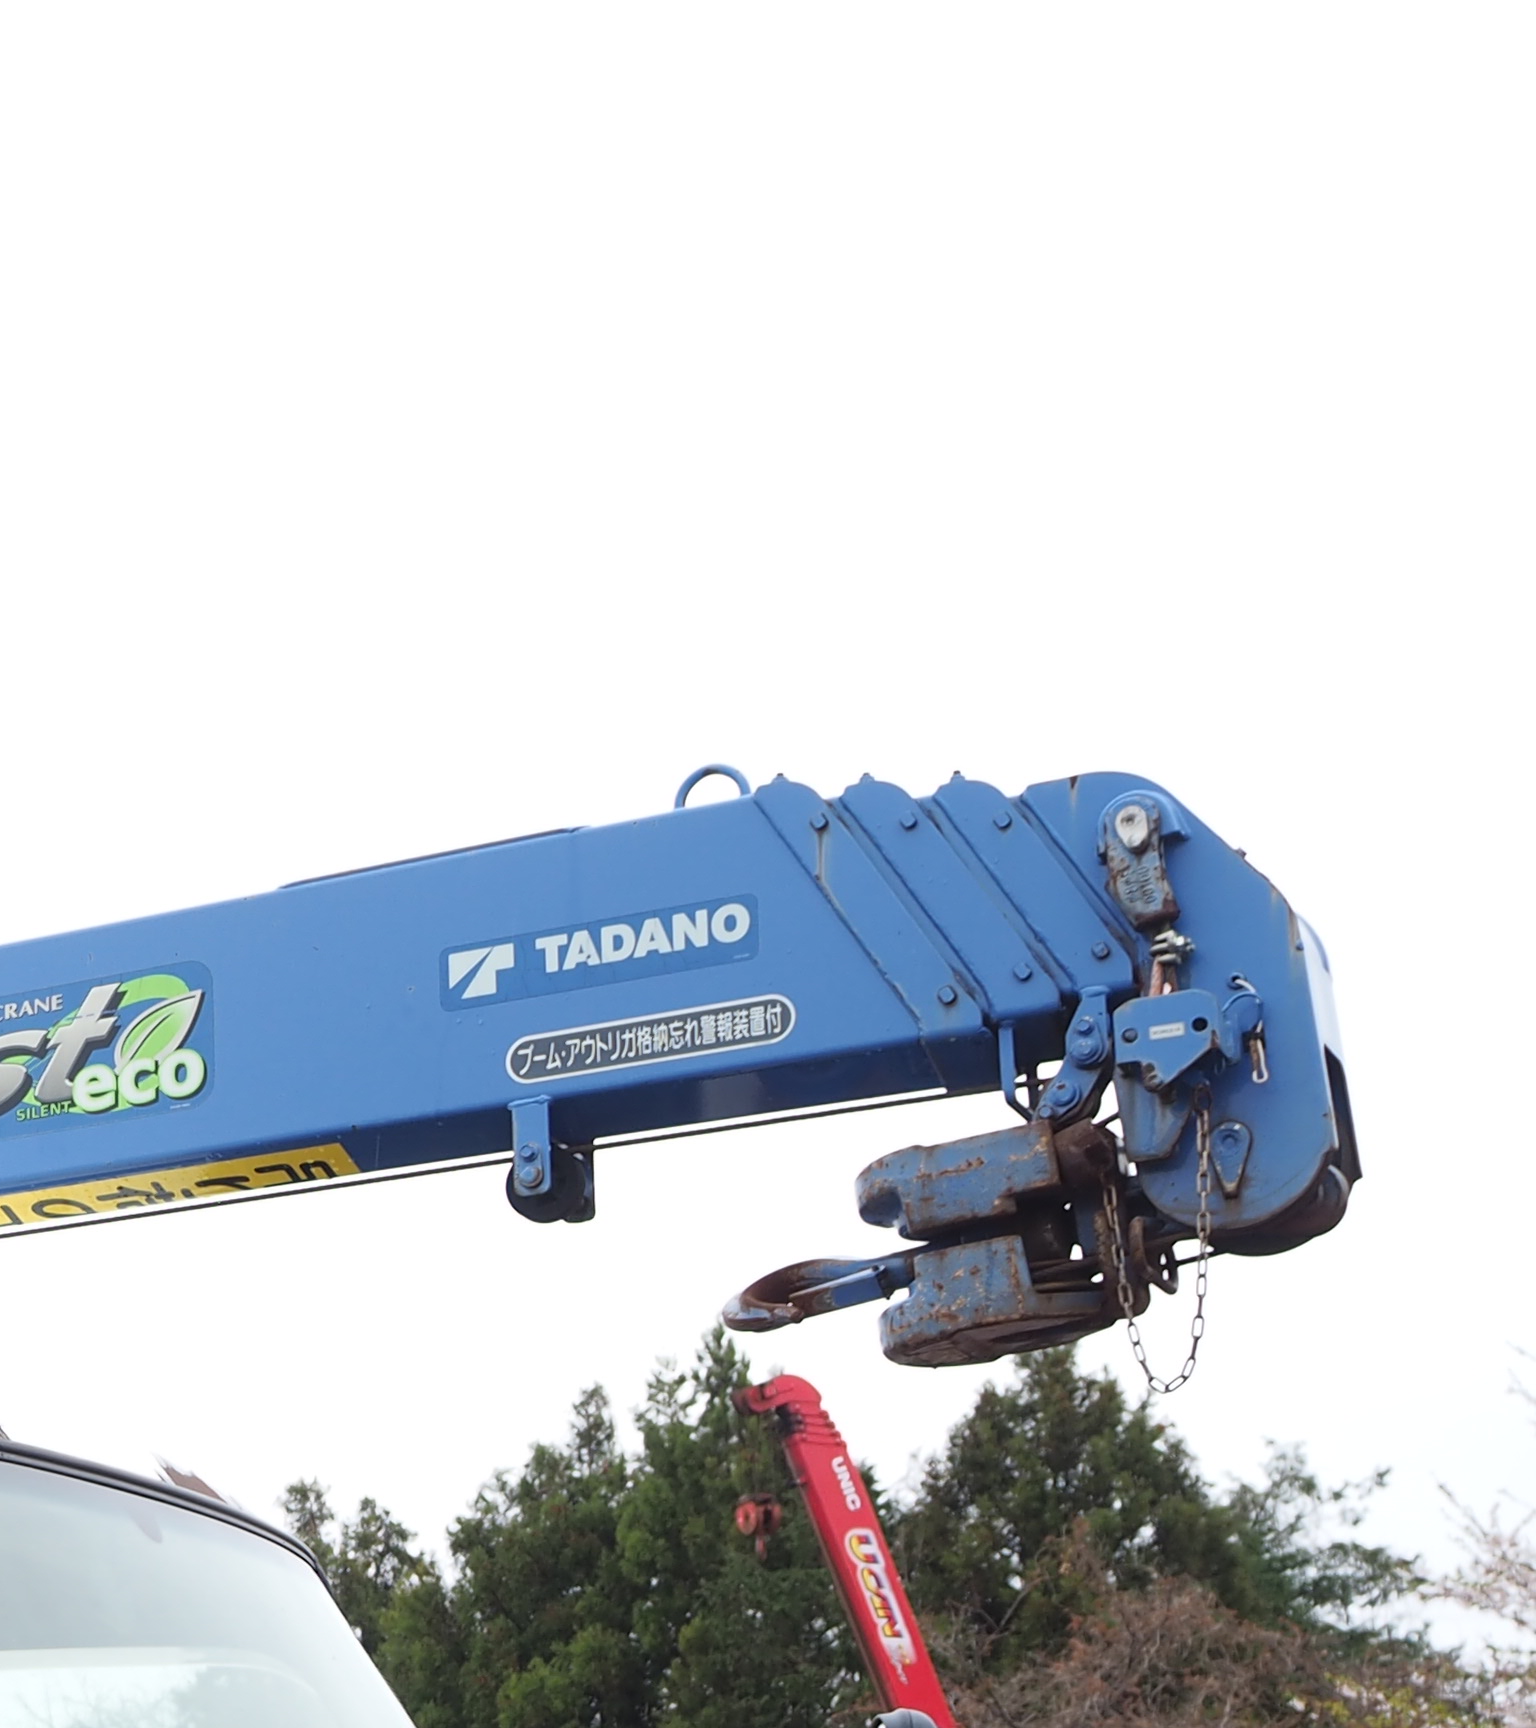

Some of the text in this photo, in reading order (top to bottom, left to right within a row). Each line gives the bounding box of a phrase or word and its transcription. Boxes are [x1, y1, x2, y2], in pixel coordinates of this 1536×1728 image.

[534, 902, 751, 974] TADANO
[15, 1101, 72, 1122] SILENT
[71, 1046, 208, 1115] eco
[831, 1455, 861, 1512] UNIC
